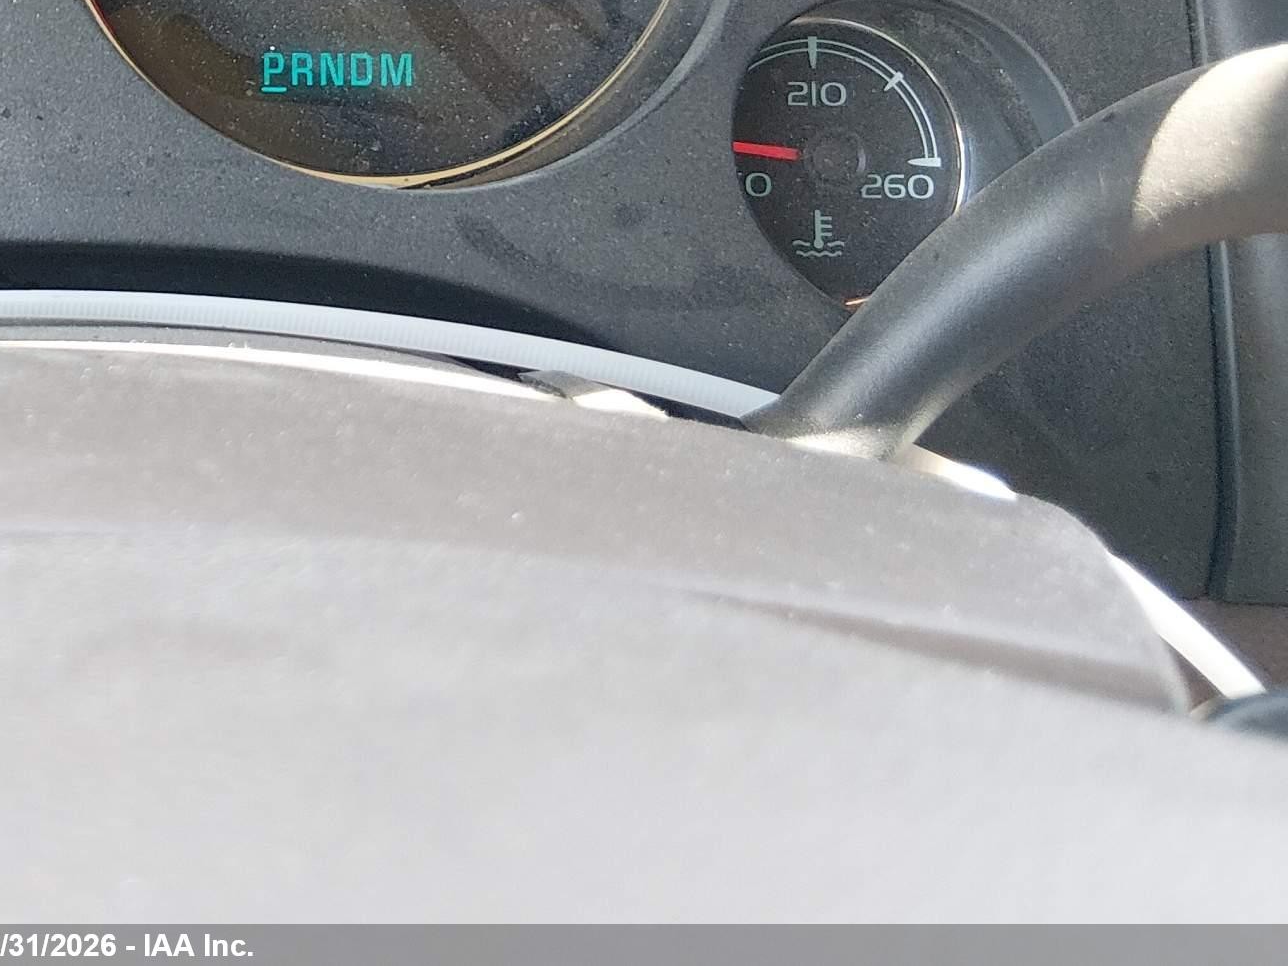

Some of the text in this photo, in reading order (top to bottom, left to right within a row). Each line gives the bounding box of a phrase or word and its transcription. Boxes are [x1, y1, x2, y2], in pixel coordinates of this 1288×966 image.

[262, 52, 413, 87] PRNDM
[787, 81, 847, 107] 210
[860, 174, 934, 200] 260
